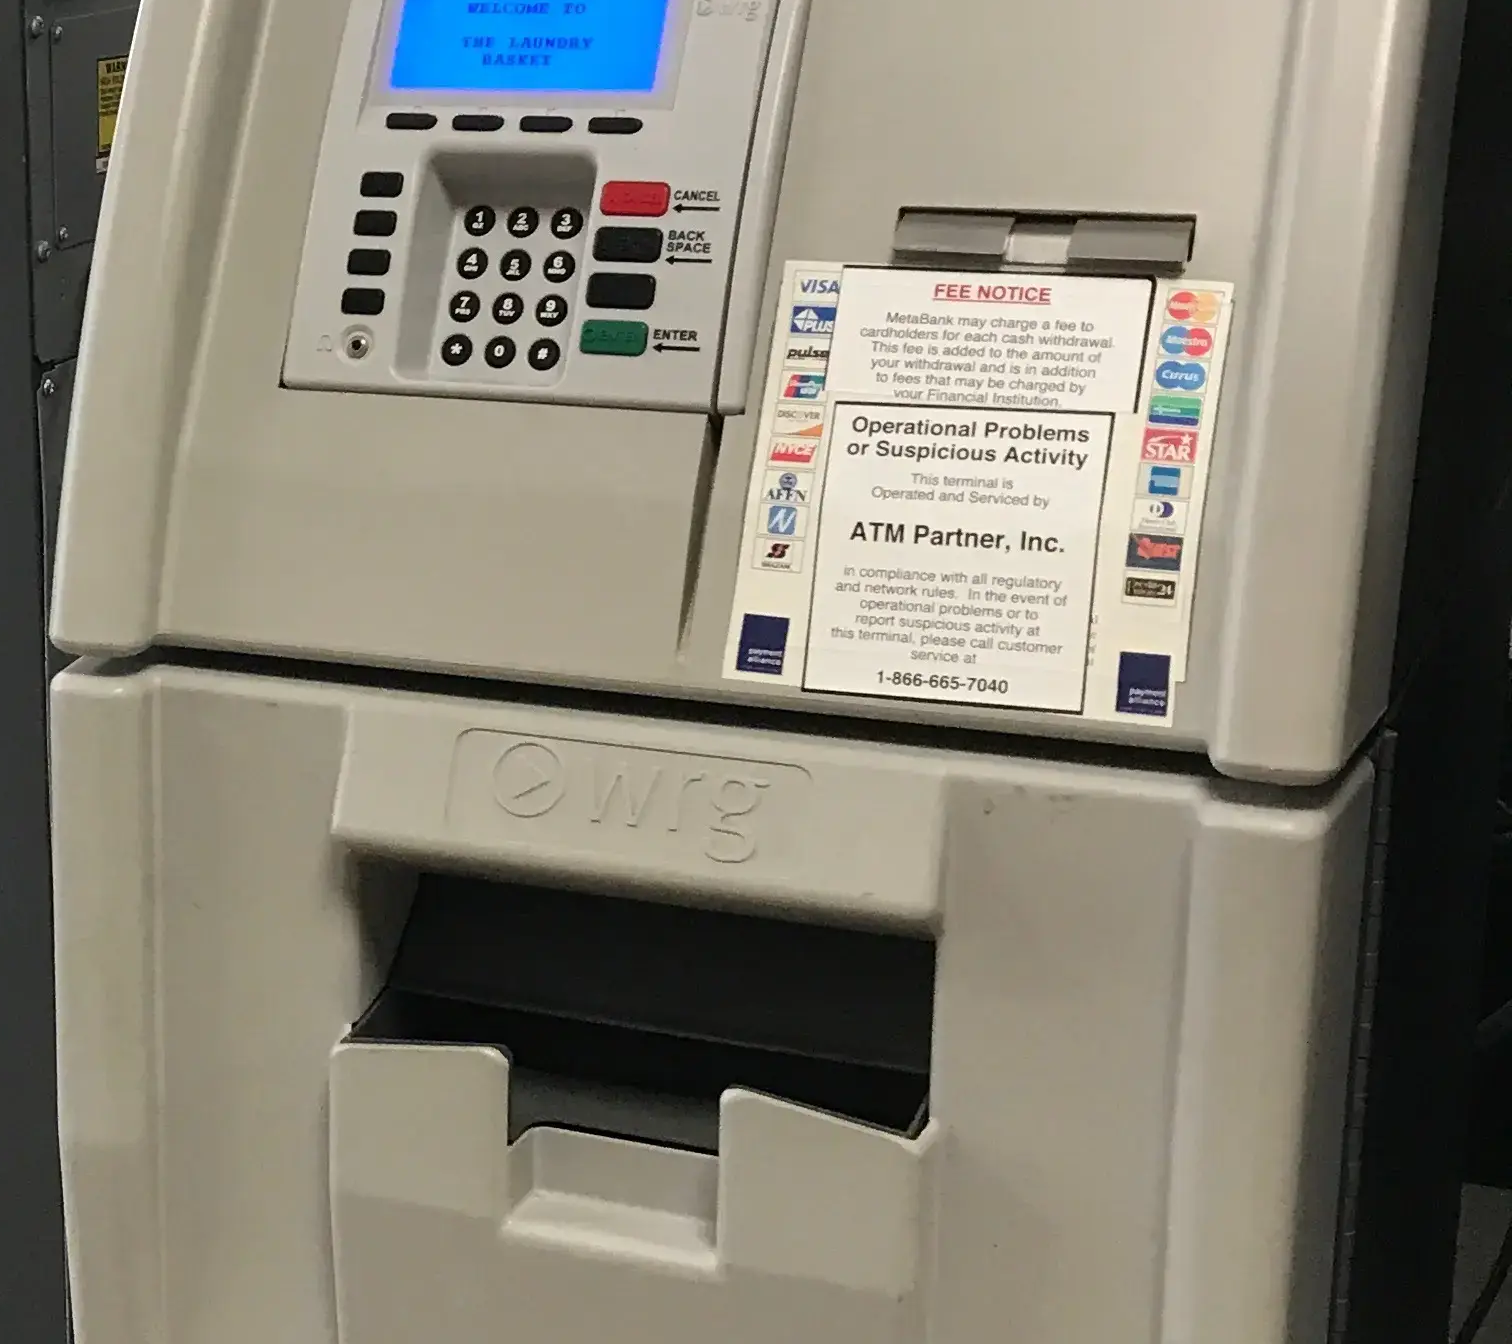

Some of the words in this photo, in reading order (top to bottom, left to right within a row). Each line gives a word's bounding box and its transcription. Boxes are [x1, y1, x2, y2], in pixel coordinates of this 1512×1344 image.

[467, 2, 550, 14] WELCOME
[563, 2, 587, 15] TO
[462, 36, 495, 48] THE
[508, 36, 594, 50] LAUNDRY
[482, 53, 552, 66] BASKET
[674, 190, 720, 202] CANCEL
[475, 211, 484, 222] 1
[517, 213, 528, 224] 2
[561, 214, 571, 225] 3
[668, 230, 705, 241] BACK
[666, 242, 711, 254] SPACE
[466, 253, 478, 264] 4
[510, 258, 520, 269] 5
[553, 256, 564, 268] 6
[801, 279, 839, 294] VISA
[934, 283, 972, 299] FEE
[977, 285, 1052, 302] NOTICE
[460, 296, 471, 307] 7
[502, 298, 513, 309] 8
[545, 300, 556, 311] 9
[498, 309, 515, 317] TUV
[804, 320, 833, 332] PLUS
[886, 312, 954, 326] MetaBank
[958, 317, 986, 330] may
[990, 317, 1039, 332] charge
[1042, 321, 1051, 330] a
[1054, 319, 1077, 331] fee
[1081, 321, 1094, 332] to
[653, 328, 698, 341] ENTER
[860, 326, 938, 341] cardholders
[942, 330, 960, 341] for
[964, 331, 997, 343] each
[1001, 333, 1034, 345] cash
[1038, 333, 1115, 348] withdrawal.
[787, 346, 828, 359] pulse
[871, 340, 899, 354] This
[902, 342, 923, 355] fee
[927, 343, 938, 355] is
[942, 344, 985, 357] added
[989, 346, 1002, 358] to
[1006, 347, 1028, 360] the
[1032, 350, 1084, 362] amount
[1088, 351, 1101, 364] of
[870, 357, 899, 370] your
[904, 357, 976, 372] withdrawal
[979, 361, 1005, 374] and
[1009, 363, 1020, 375] is
[1024, 364, 1037, 376] in
[1041, 365, 1095, 378] addition
[876, 371, 888, 383] to
[892, 372, 921, 385] fees
[925, 373, 952, 386] that
[955, 377, 984, 390] may
[987, 376, 1005, 389] be
[1008, 378, 1065, 394] charged
[1068, 381, 1086, 395] by
[893, 389, 923, 400] your
[927, 388, 989, 403] Financial
[992, 392, 1062, 407] Institution.
[852, 415, 977, 438] Operational
[984, 422, 1090, 443] Problems
[775, 443, 816, 455] NYCE
[847, 442, 869, 455] or
[875, 440, 996, 462] Suspicious
[1004, 446, 1088, 470] Activity
[1145, 443, 1191, 460] STAR
[911, 473, 939, 486] This
[943, 475, 998, 489] terminal
[1002, 478, 1014, 490] is
[871, 486, 934, 501] Operated
[938, 490, 964, 503] and
[968, 491, 1029, 506] Serviced
[1033, 495, 1049, 510] by
[849, 521, 905, 544] ATM
[913, 524, 1011, 554] Partner,
[1020, 530, 1065, 553] Inc.
[843, 565, 856, 577] in
[859, 566, 936, 584] compliance
[940, 570, 968, 584] with
[971, 572, 987, 585] all
[991, 574, 1062, 592] regulatory
[835, 581, 860, 593] and
[864, 582, 917, 596] network
[921, 586, 958, 600] rules.
[968, 588, 981, 600] In
[984, 589, 1007, 602] the
[1010, 592, 1049, 605] event
[1053, 593, 1068, 606] of
[859, 597, 935, 613] operational
[938, 603, 1002, 620] problems
[1006, 609, 1021, 619] or
[1024, 609, 1038, 620] to
[855, 613, 895, 627] report
[899, 616, 970, 633] suspicious
[974, 622, 1022, 637] activity
[1026, 626, 1040, 636] at
[831, 626, 854, 639] this
[858, 629, 916, 645] terminal,
[920, 633, 965, 647] please
[970, 637, 993, 649] call
[997, 640, 1062, 654] customer
[910, 649, 959, 663] service
[963, 653, 977, 664] at
[876, 670, 1009, 694] 1-866-665-7040
